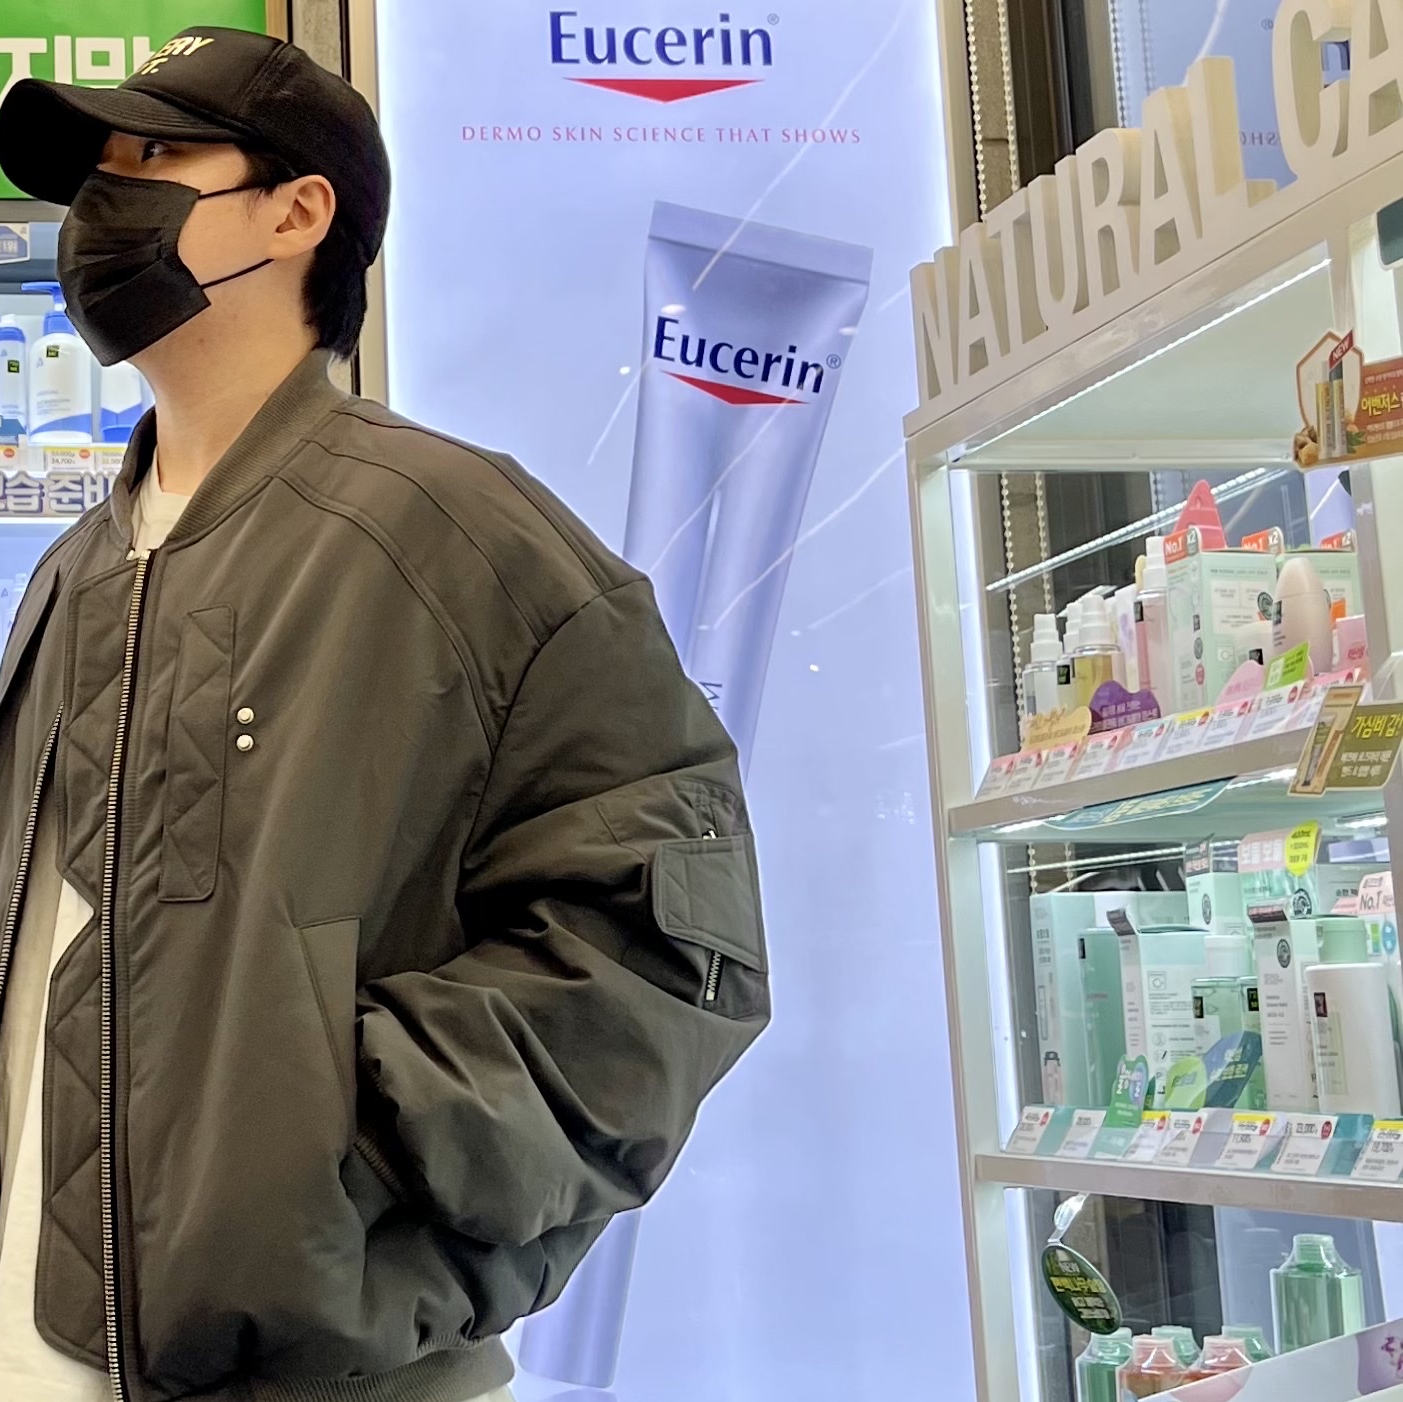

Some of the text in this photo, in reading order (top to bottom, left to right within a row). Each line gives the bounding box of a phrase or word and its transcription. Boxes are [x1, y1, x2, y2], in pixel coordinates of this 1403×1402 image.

[150, 36, 214, 59] ERY
[462, 126, 861, 144] DERMO SKIN SCIENCE THAT SHOWS
[910, 56, 1278, 400] NATURAL
